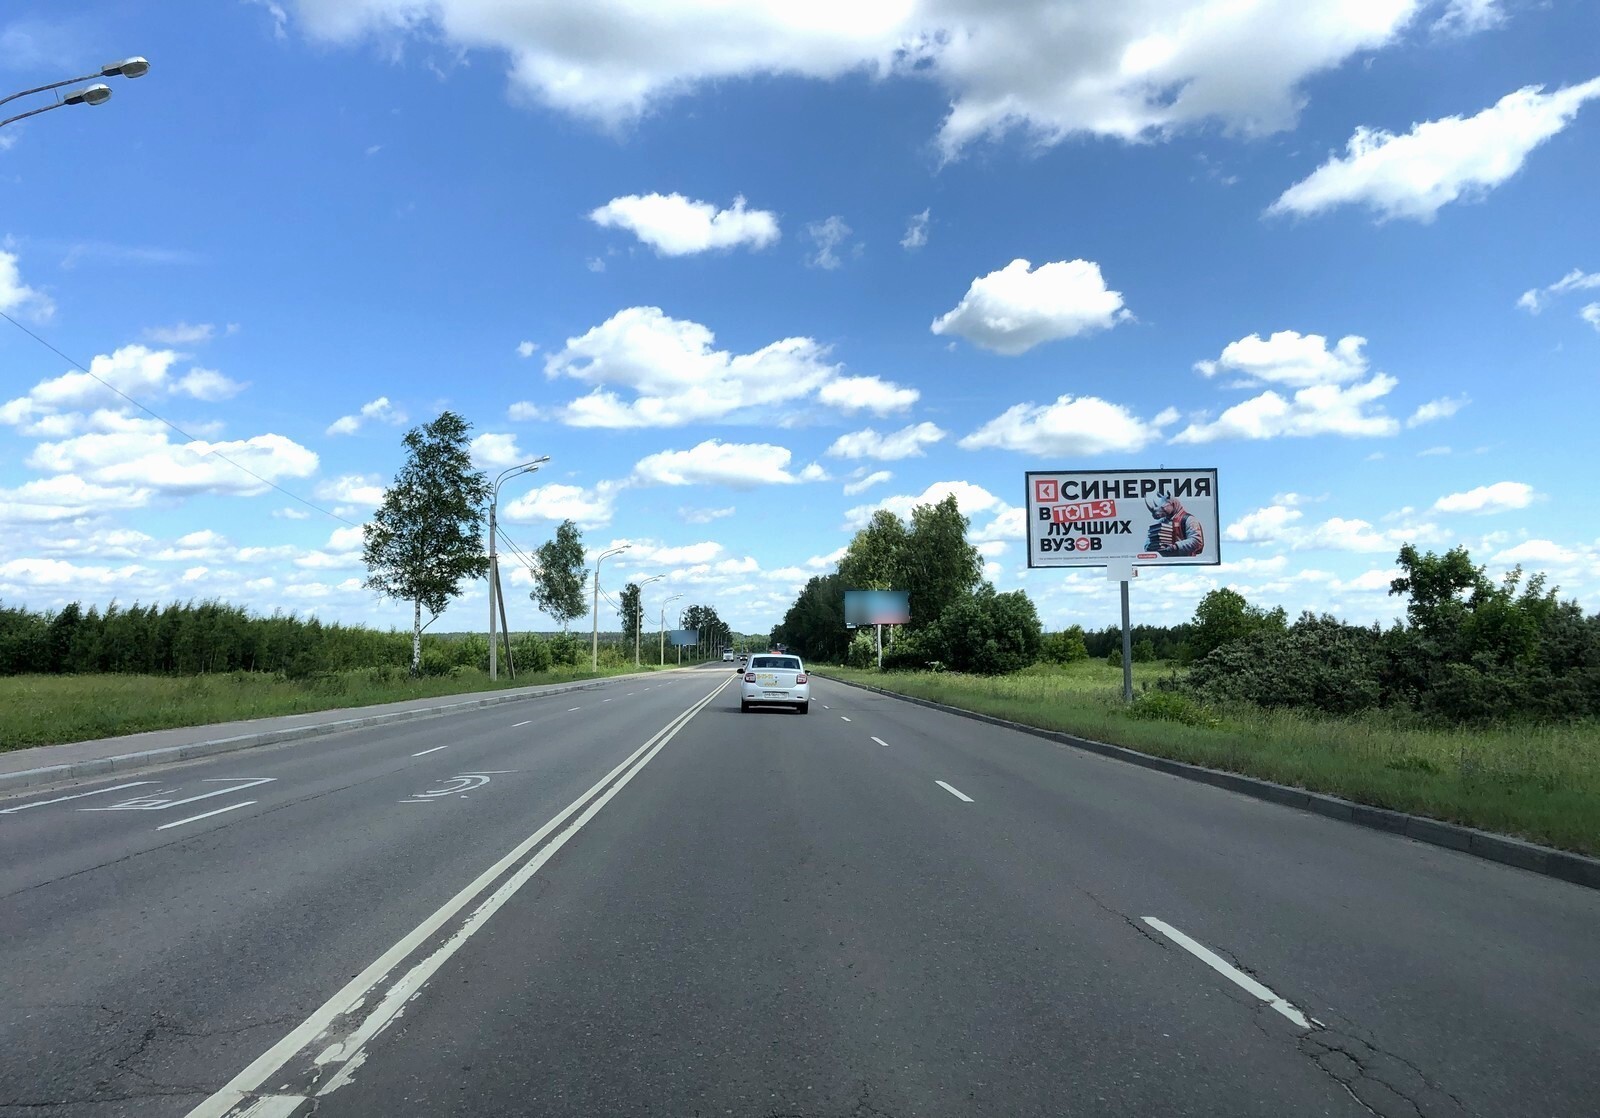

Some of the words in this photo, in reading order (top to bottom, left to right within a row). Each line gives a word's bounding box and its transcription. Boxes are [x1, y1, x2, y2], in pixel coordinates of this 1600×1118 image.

[1061, 478, 1211, 500] СИНЕРГИЯ
[1039, 507, 1051, 520] В
[1048, 521, 1132, 535] ЛУЧШИХ
[1040, 537, 1102, 552] ВУЗОВ
